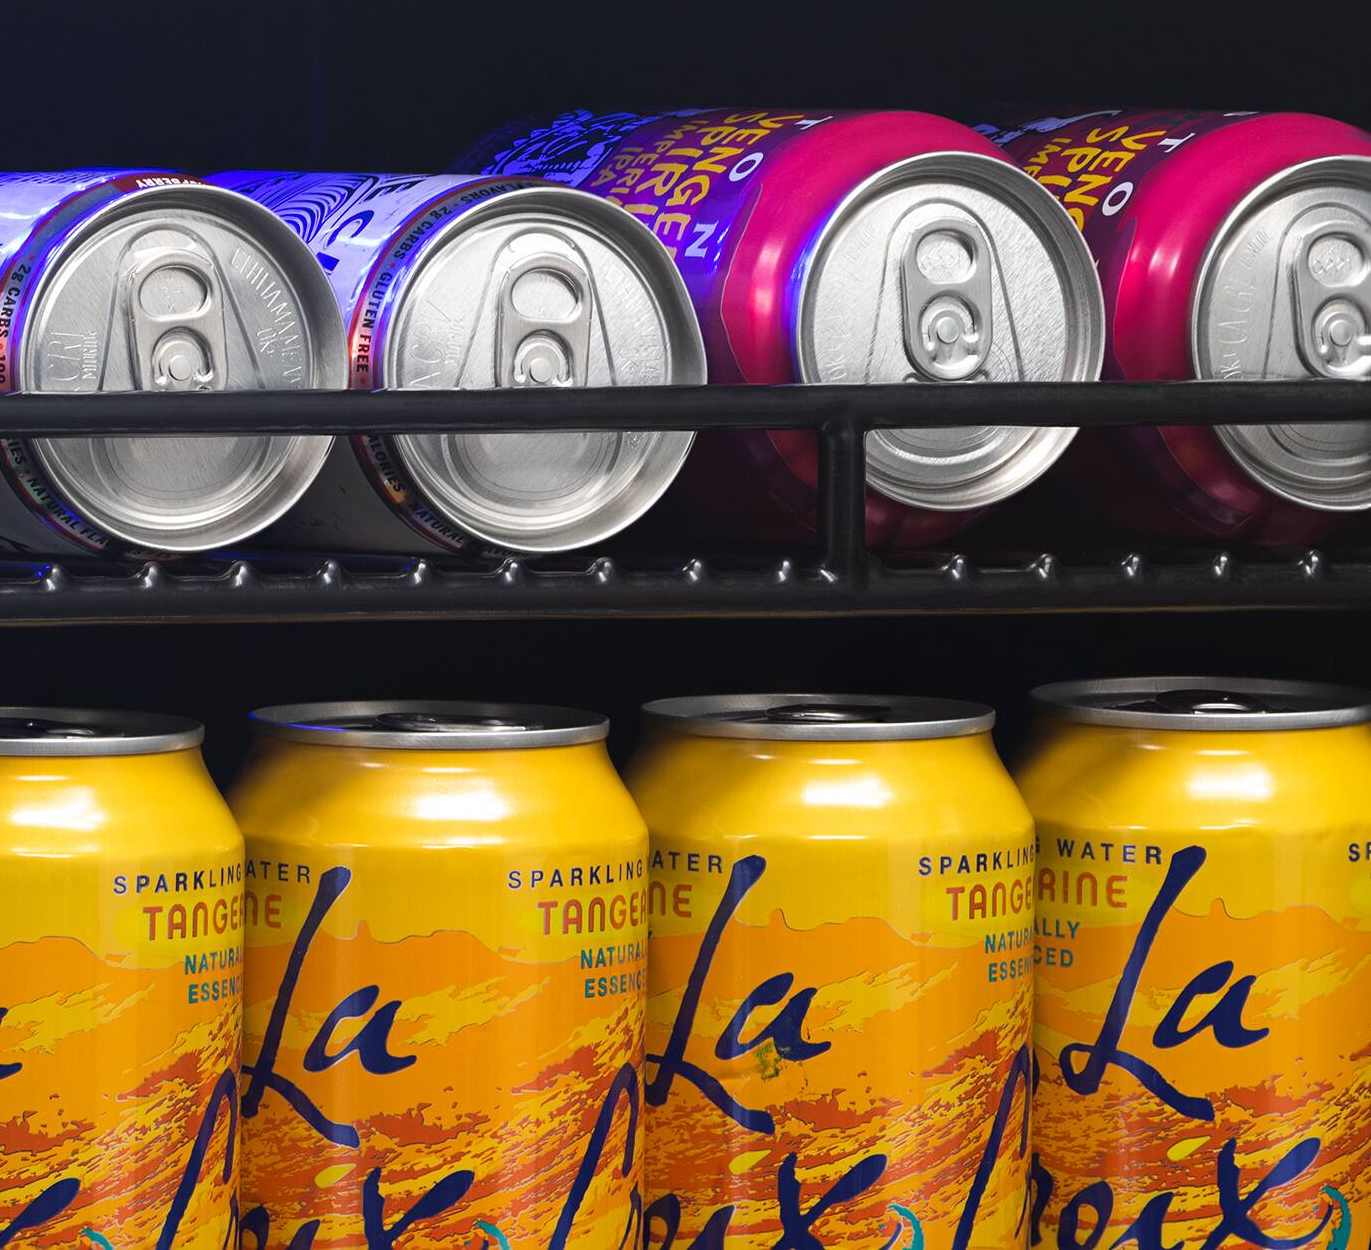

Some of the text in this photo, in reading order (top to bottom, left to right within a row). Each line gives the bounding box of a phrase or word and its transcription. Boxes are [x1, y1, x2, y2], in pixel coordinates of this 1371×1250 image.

[392, 220, 434, 261] CARBS
[10, 263, 32, 283] 2g
[356, 272, 393, 373] GLUTEN FREE
[26, 476, 80, 531] NATURAL
[406, 502, 465, 545] NATURAL
[651, 849, 724, 875] ATER
[918, 842, 1035, 877] SPARKLING
[1057, 837, 1163, 866] WATER
[112, 864, 243, 896] SPARKLING
[246, 860, 311, 885] ATER
[507, 858, 644, 890] SPARKLING
[645, 853, 832, 1135] La
[1059, 845, 1271, 1123] La
[241, 865, 417, 1149] La
